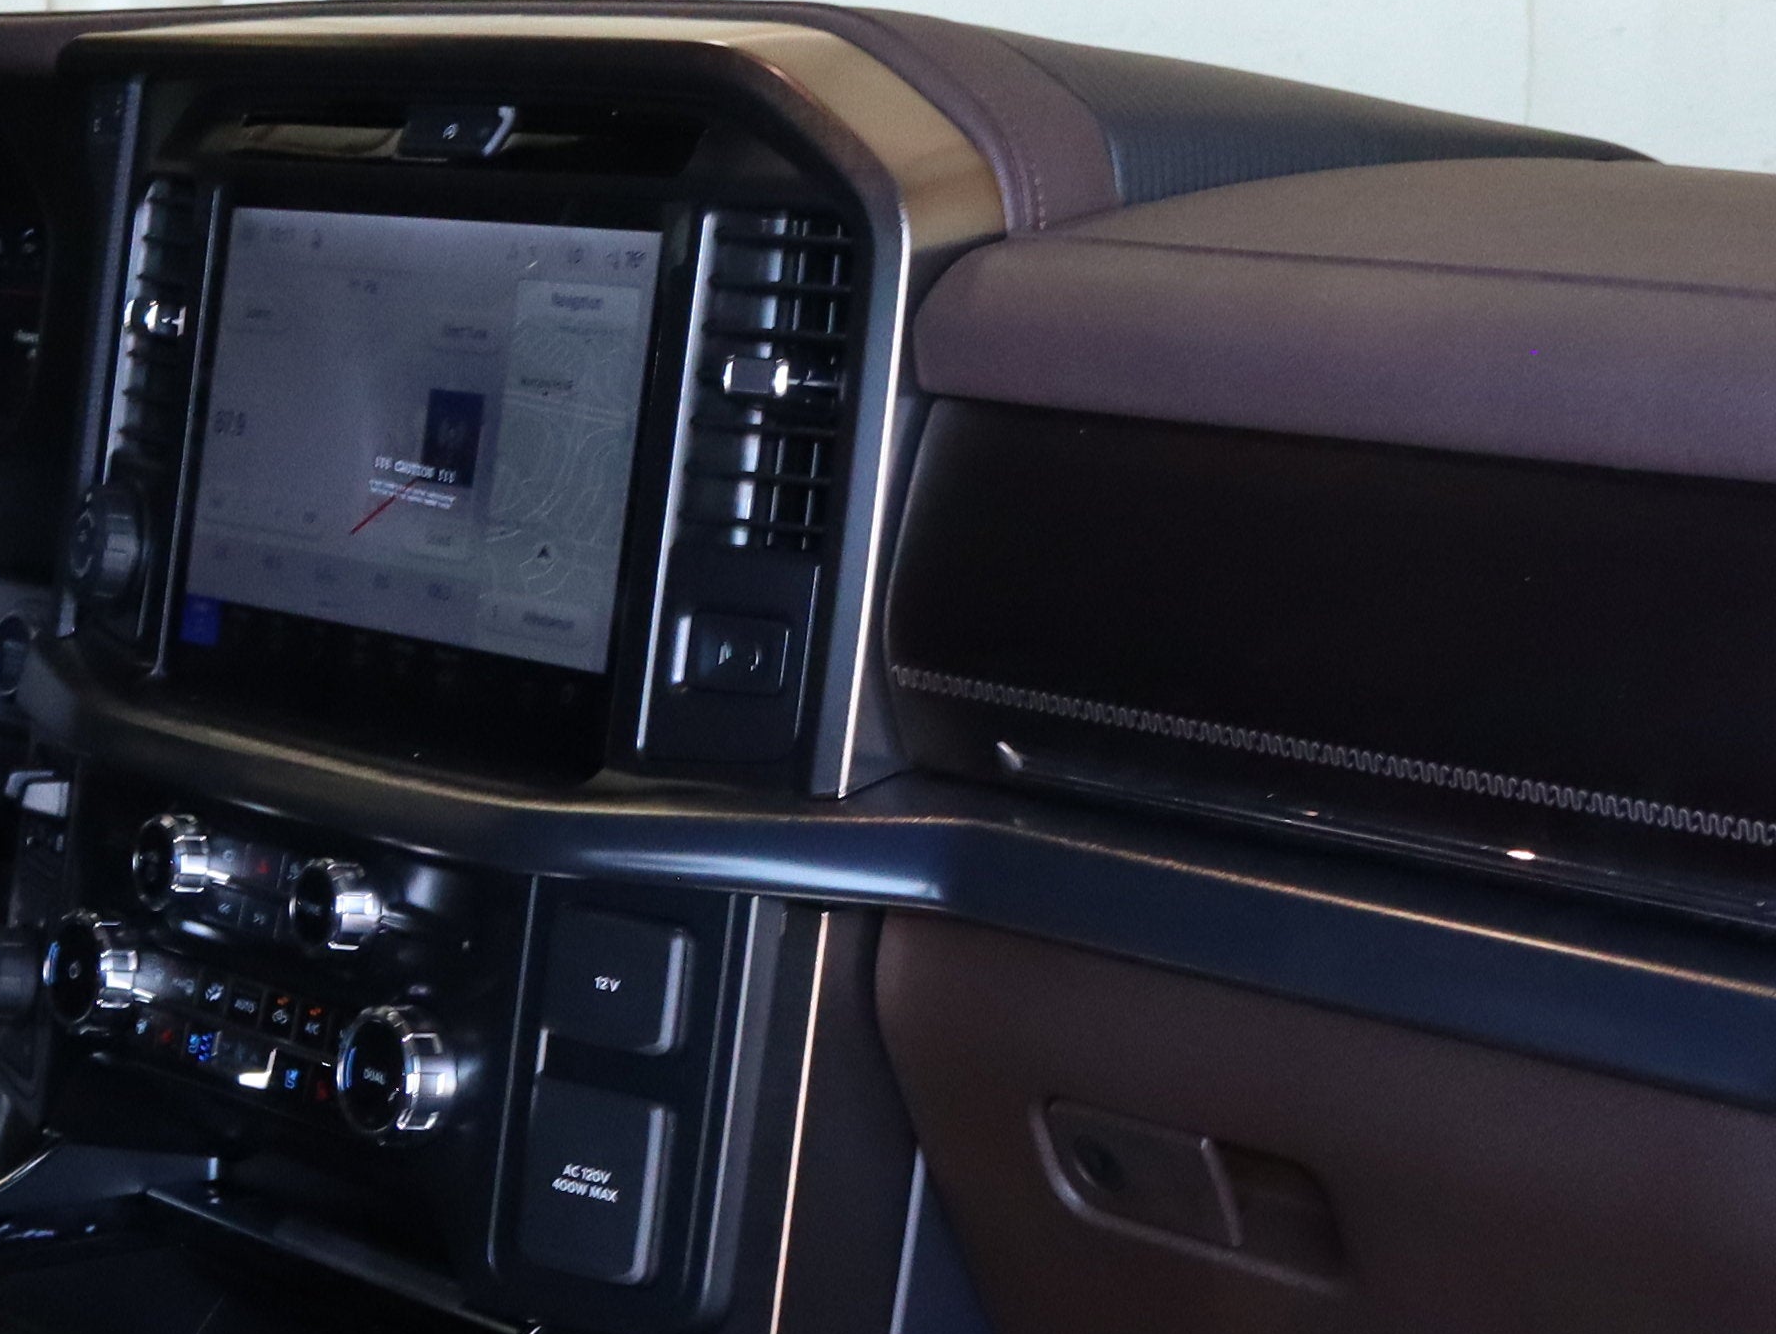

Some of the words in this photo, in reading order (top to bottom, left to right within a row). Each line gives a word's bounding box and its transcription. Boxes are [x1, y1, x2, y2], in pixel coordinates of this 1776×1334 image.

[594, 975, 621, 993] 12V
[562, 1163, 582, 1178] AC
[581, 1167, 612, 1184] 120V
[552, 1177, 590, 1195] 400W
[588, 1185, 619, 1203] MAX
